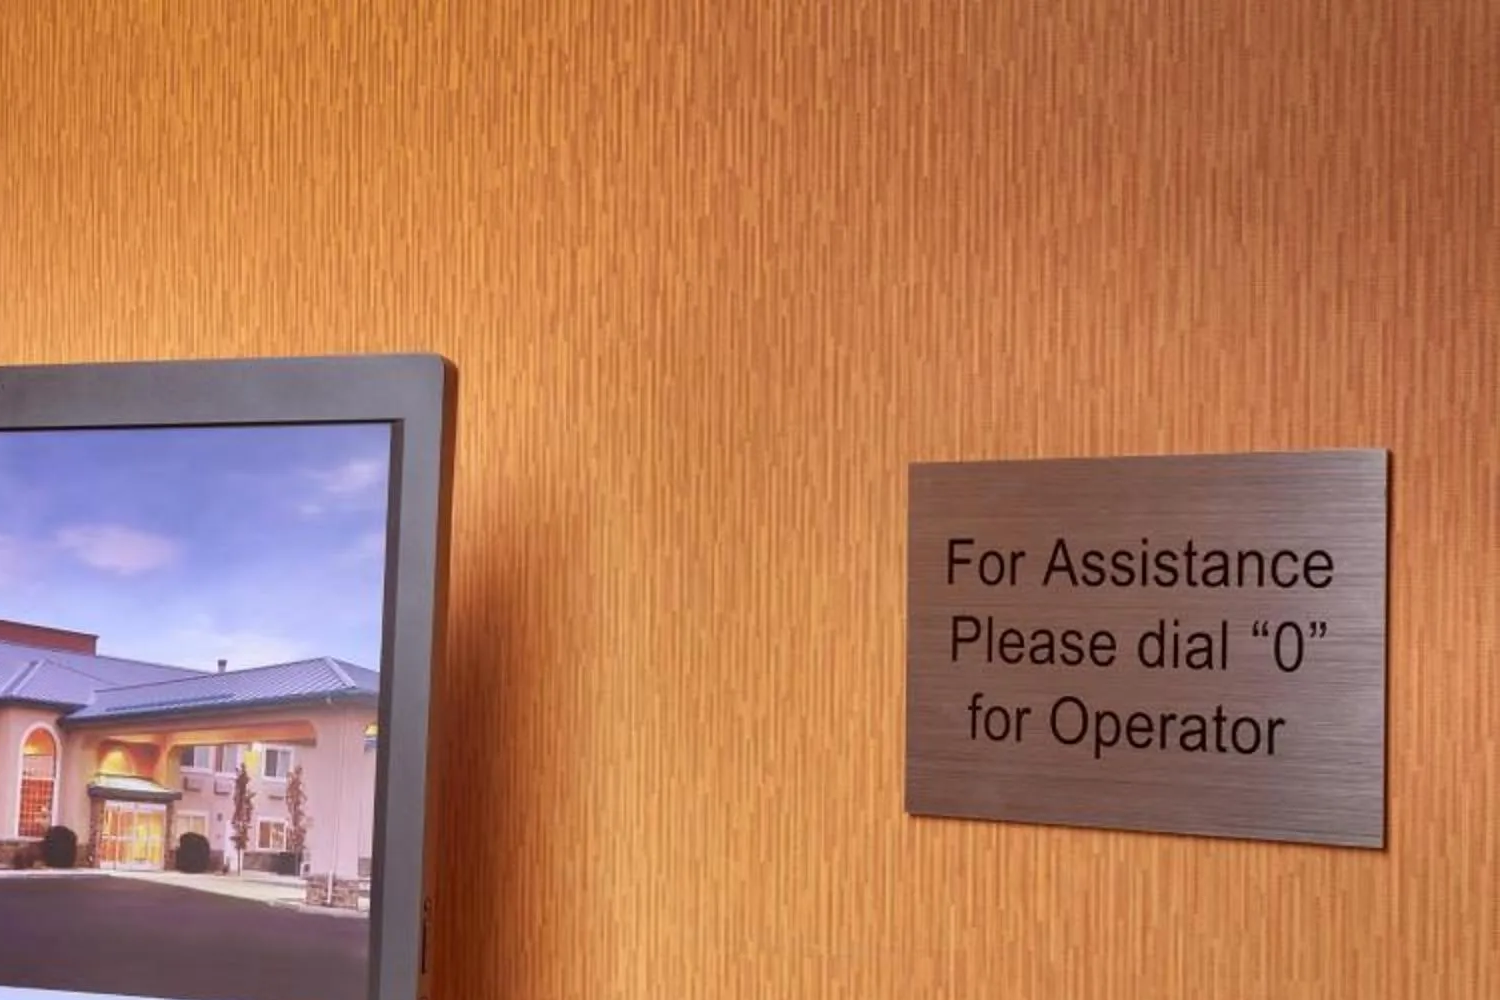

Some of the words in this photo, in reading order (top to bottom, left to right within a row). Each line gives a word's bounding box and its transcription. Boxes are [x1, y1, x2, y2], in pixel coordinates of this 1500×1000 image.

[946, 537, 1026, 587] For
[1042, 536, 1334, 589] Assistance
[951, 614, 1117, 667] Please
[1137, 618, 1228, 671] dial
[967, 691, 1032, 743] for
[1049, 695, 1286, 759] Operator
